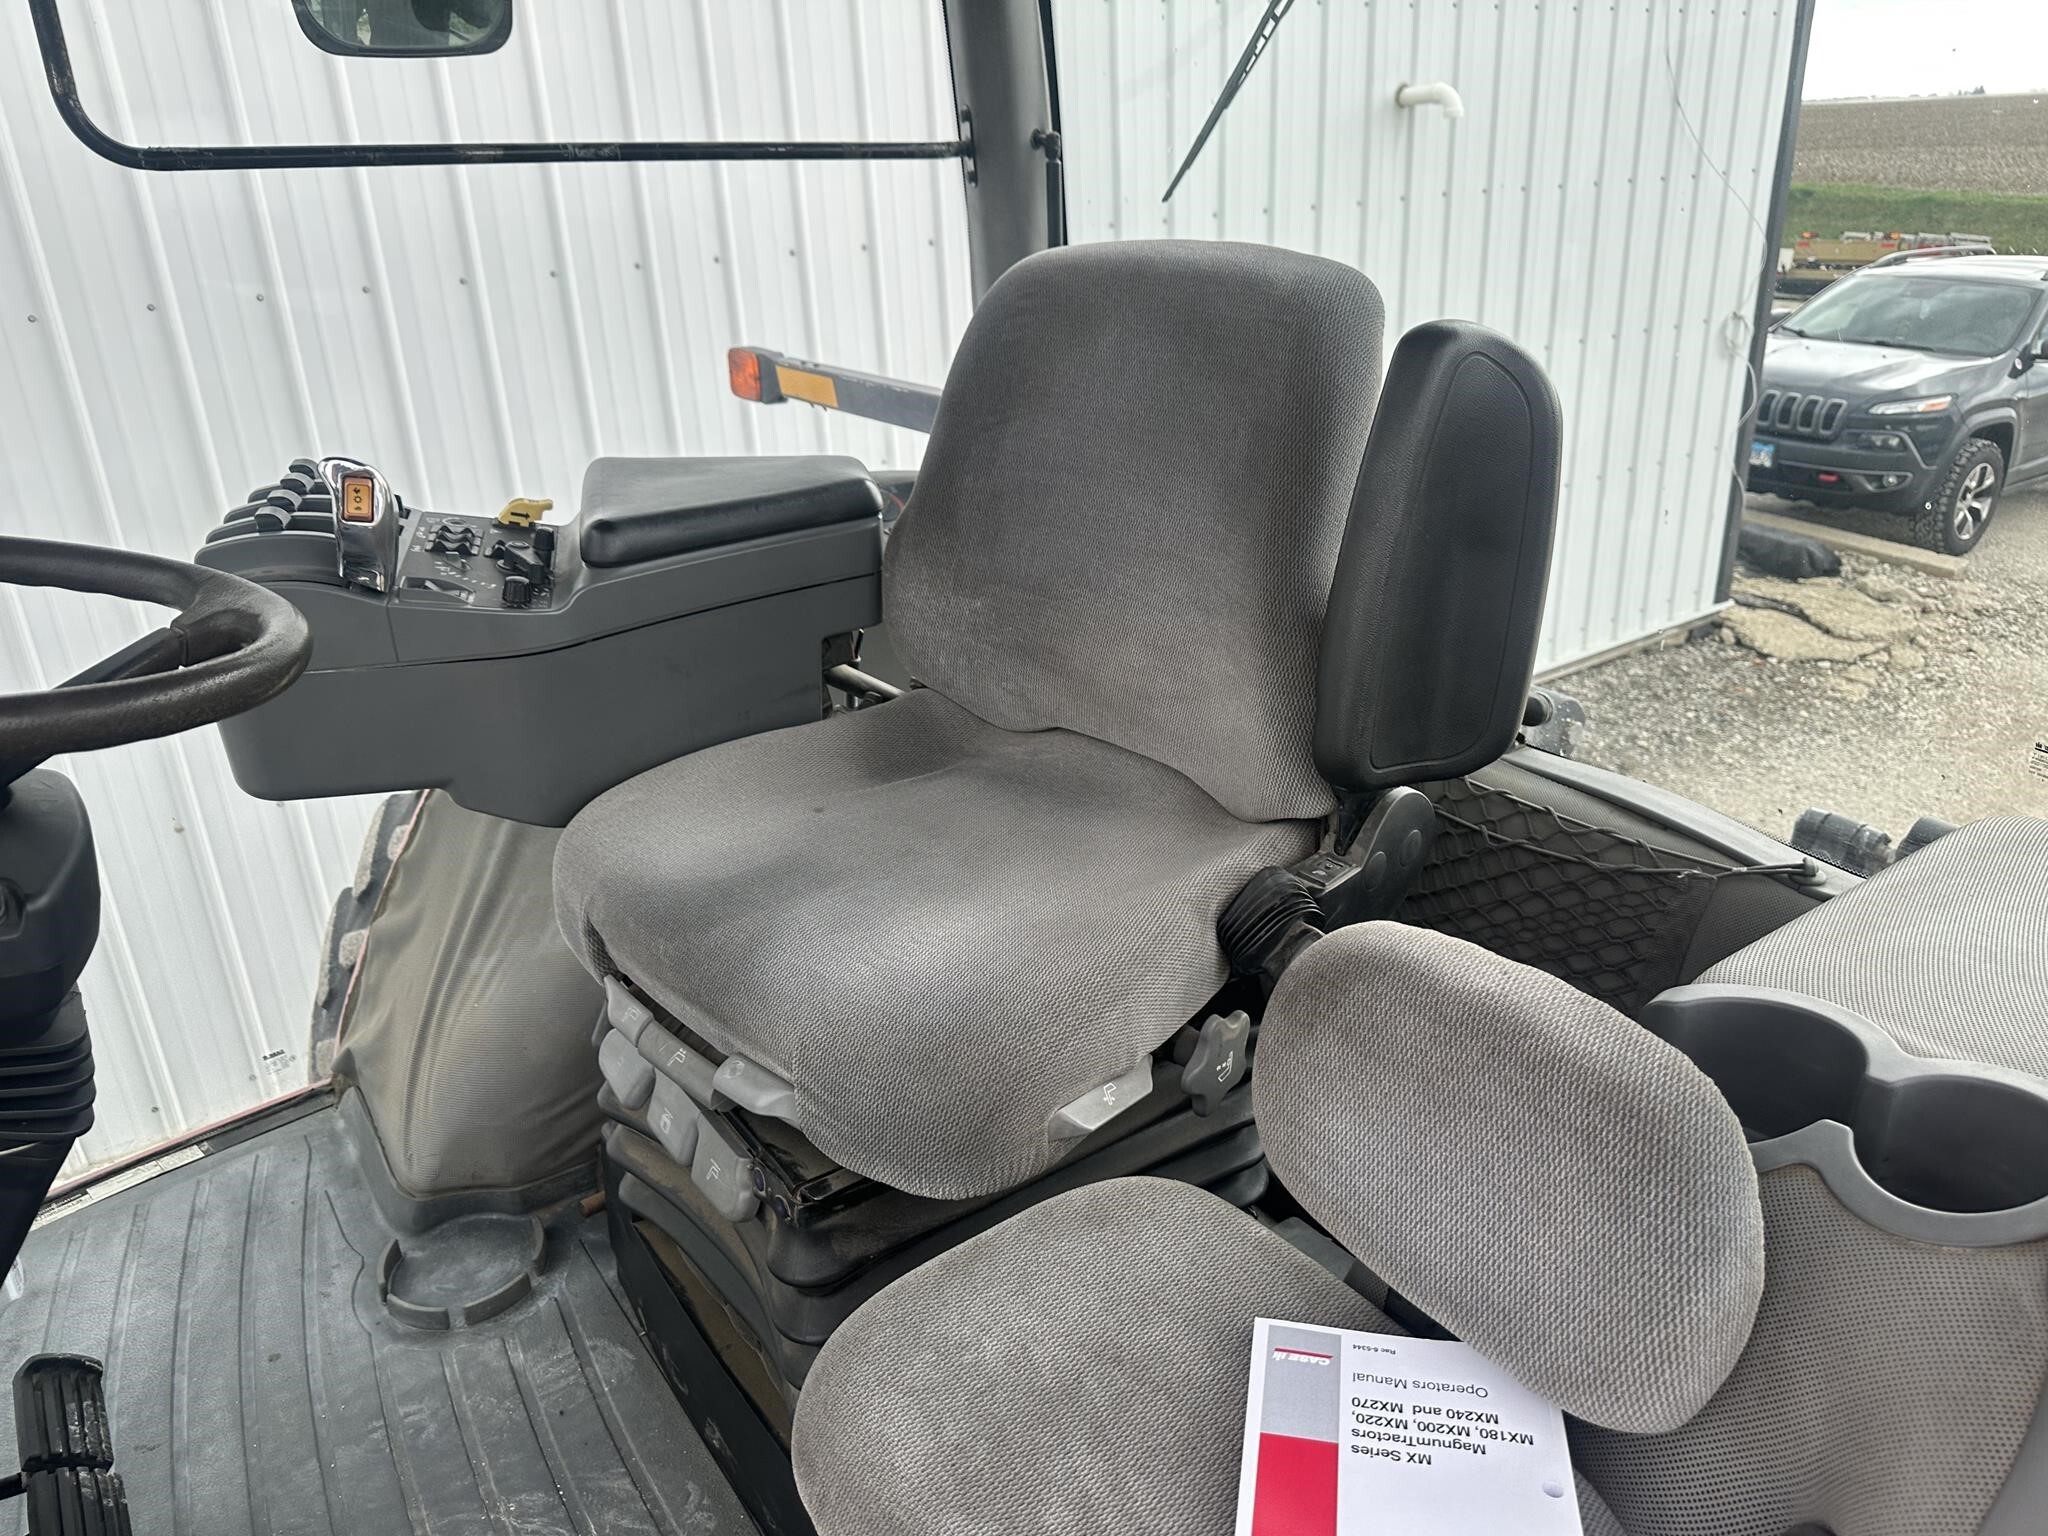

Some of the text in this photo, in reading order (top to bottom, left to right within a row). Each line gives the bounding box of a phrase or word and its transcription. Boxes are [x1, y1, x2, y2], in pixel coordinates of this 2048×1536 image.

[1288, 1354, 1331, 1366] CASE
[1352, 1344, 1396, 1355] Rac 6-5344
[1352, 1372, 1488, 1398] Operators Manual
[1351, 1396, 1499, 1425] MX240 and MX270
[1351, 1412, 1534, 1445] MX180, MX200, MX220,
[1351, 1428, 1486, 1455] MagnumTractors
[1351, 1445, 1431, 1465] MX Series
